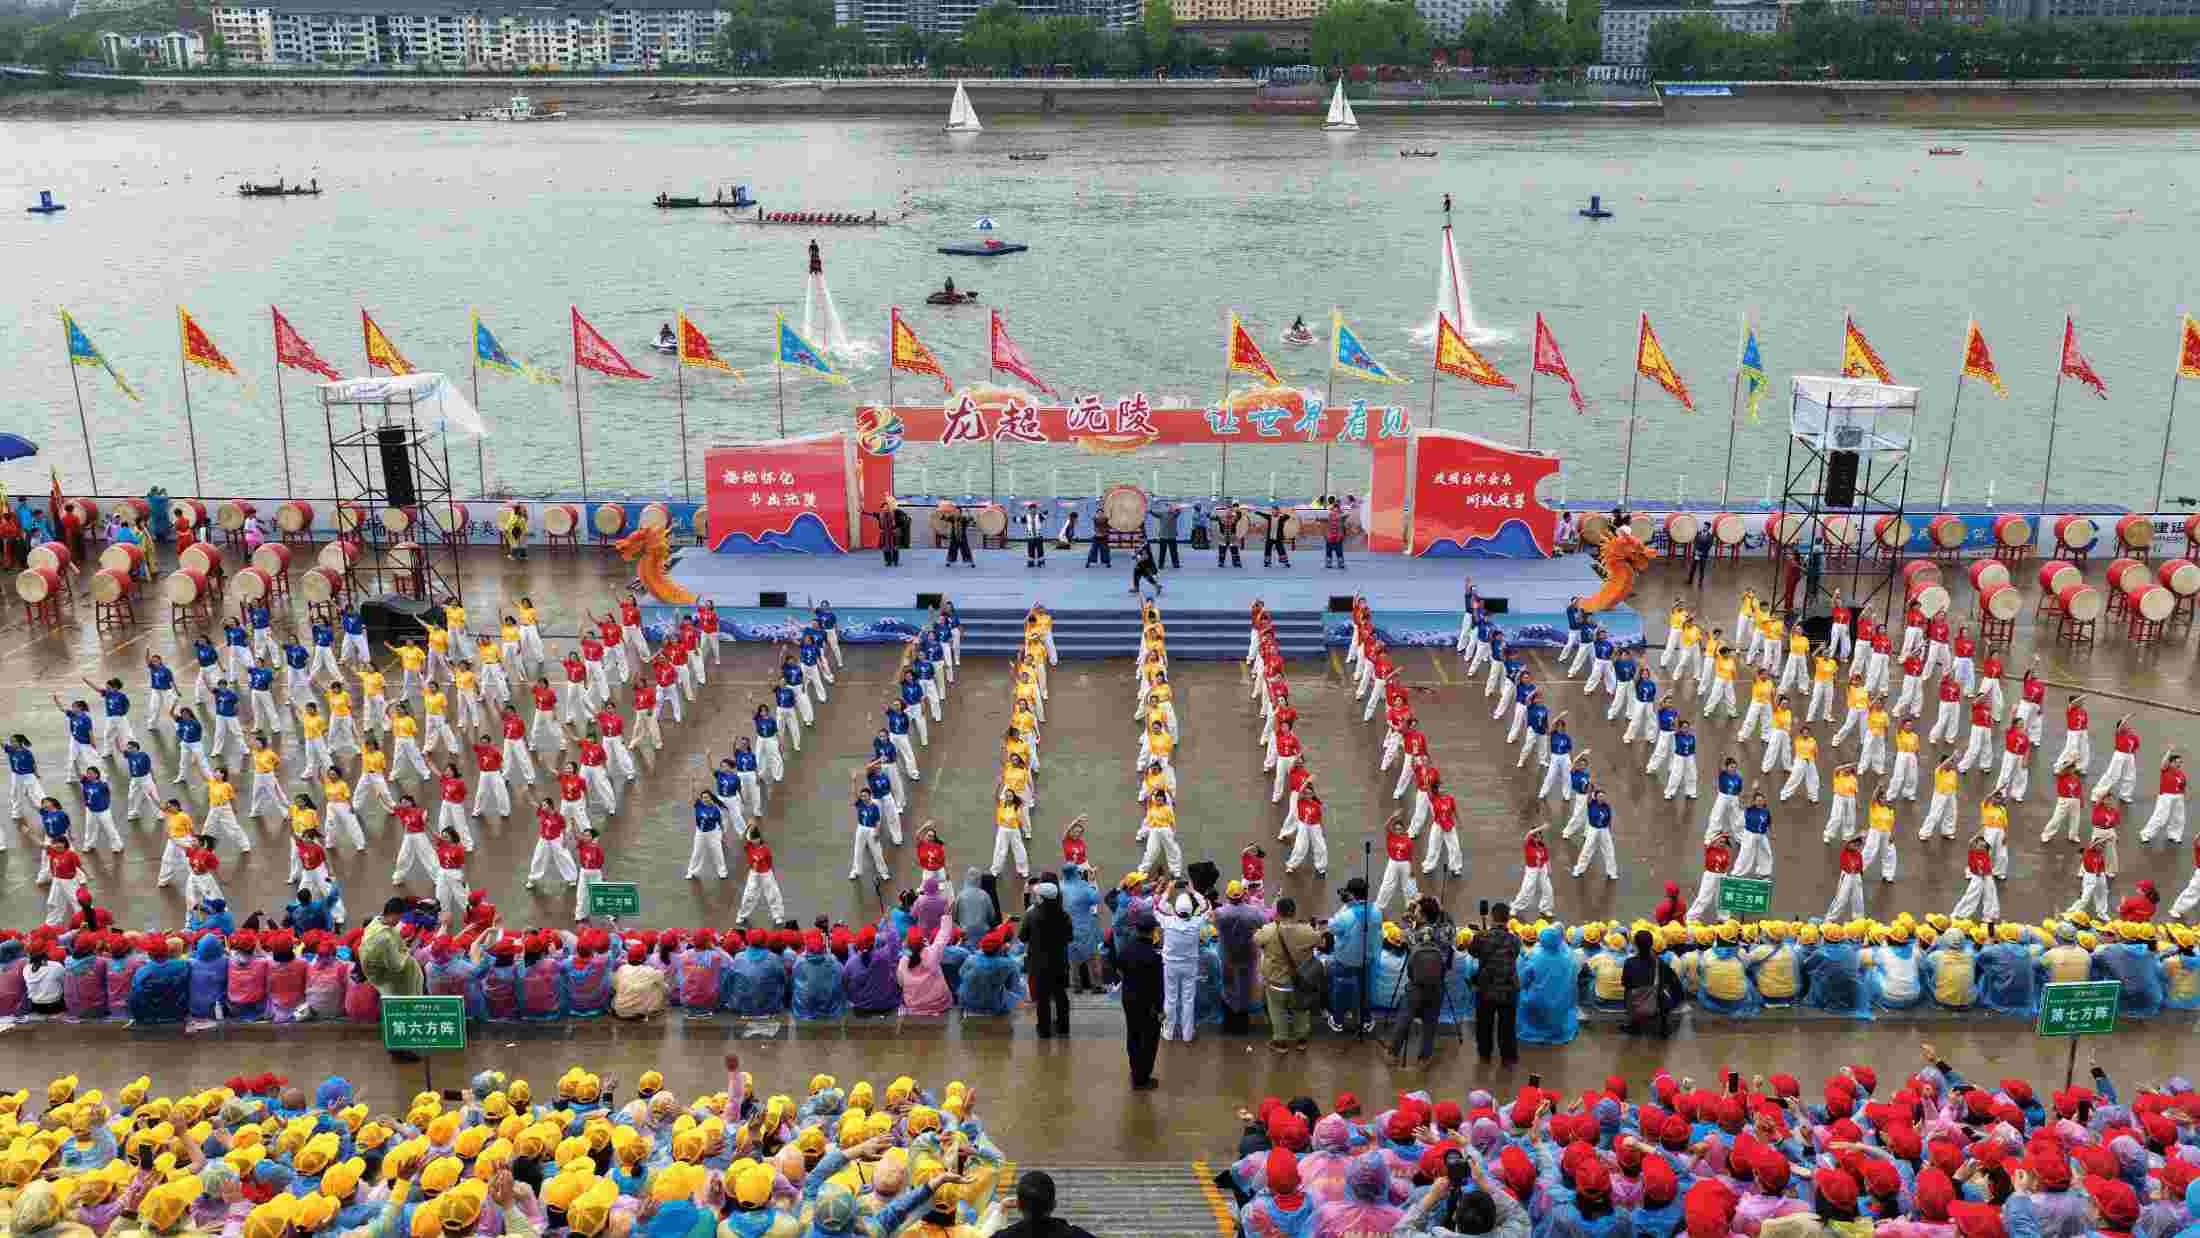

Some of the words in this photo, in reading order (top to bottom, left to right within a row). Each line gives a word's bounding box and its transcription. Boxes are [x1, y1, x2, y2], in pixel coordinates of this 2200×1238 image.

[2049, 1006, 2112, 1024] 第七方阵
[392, 1021, 456, 1036] 第六方阵
